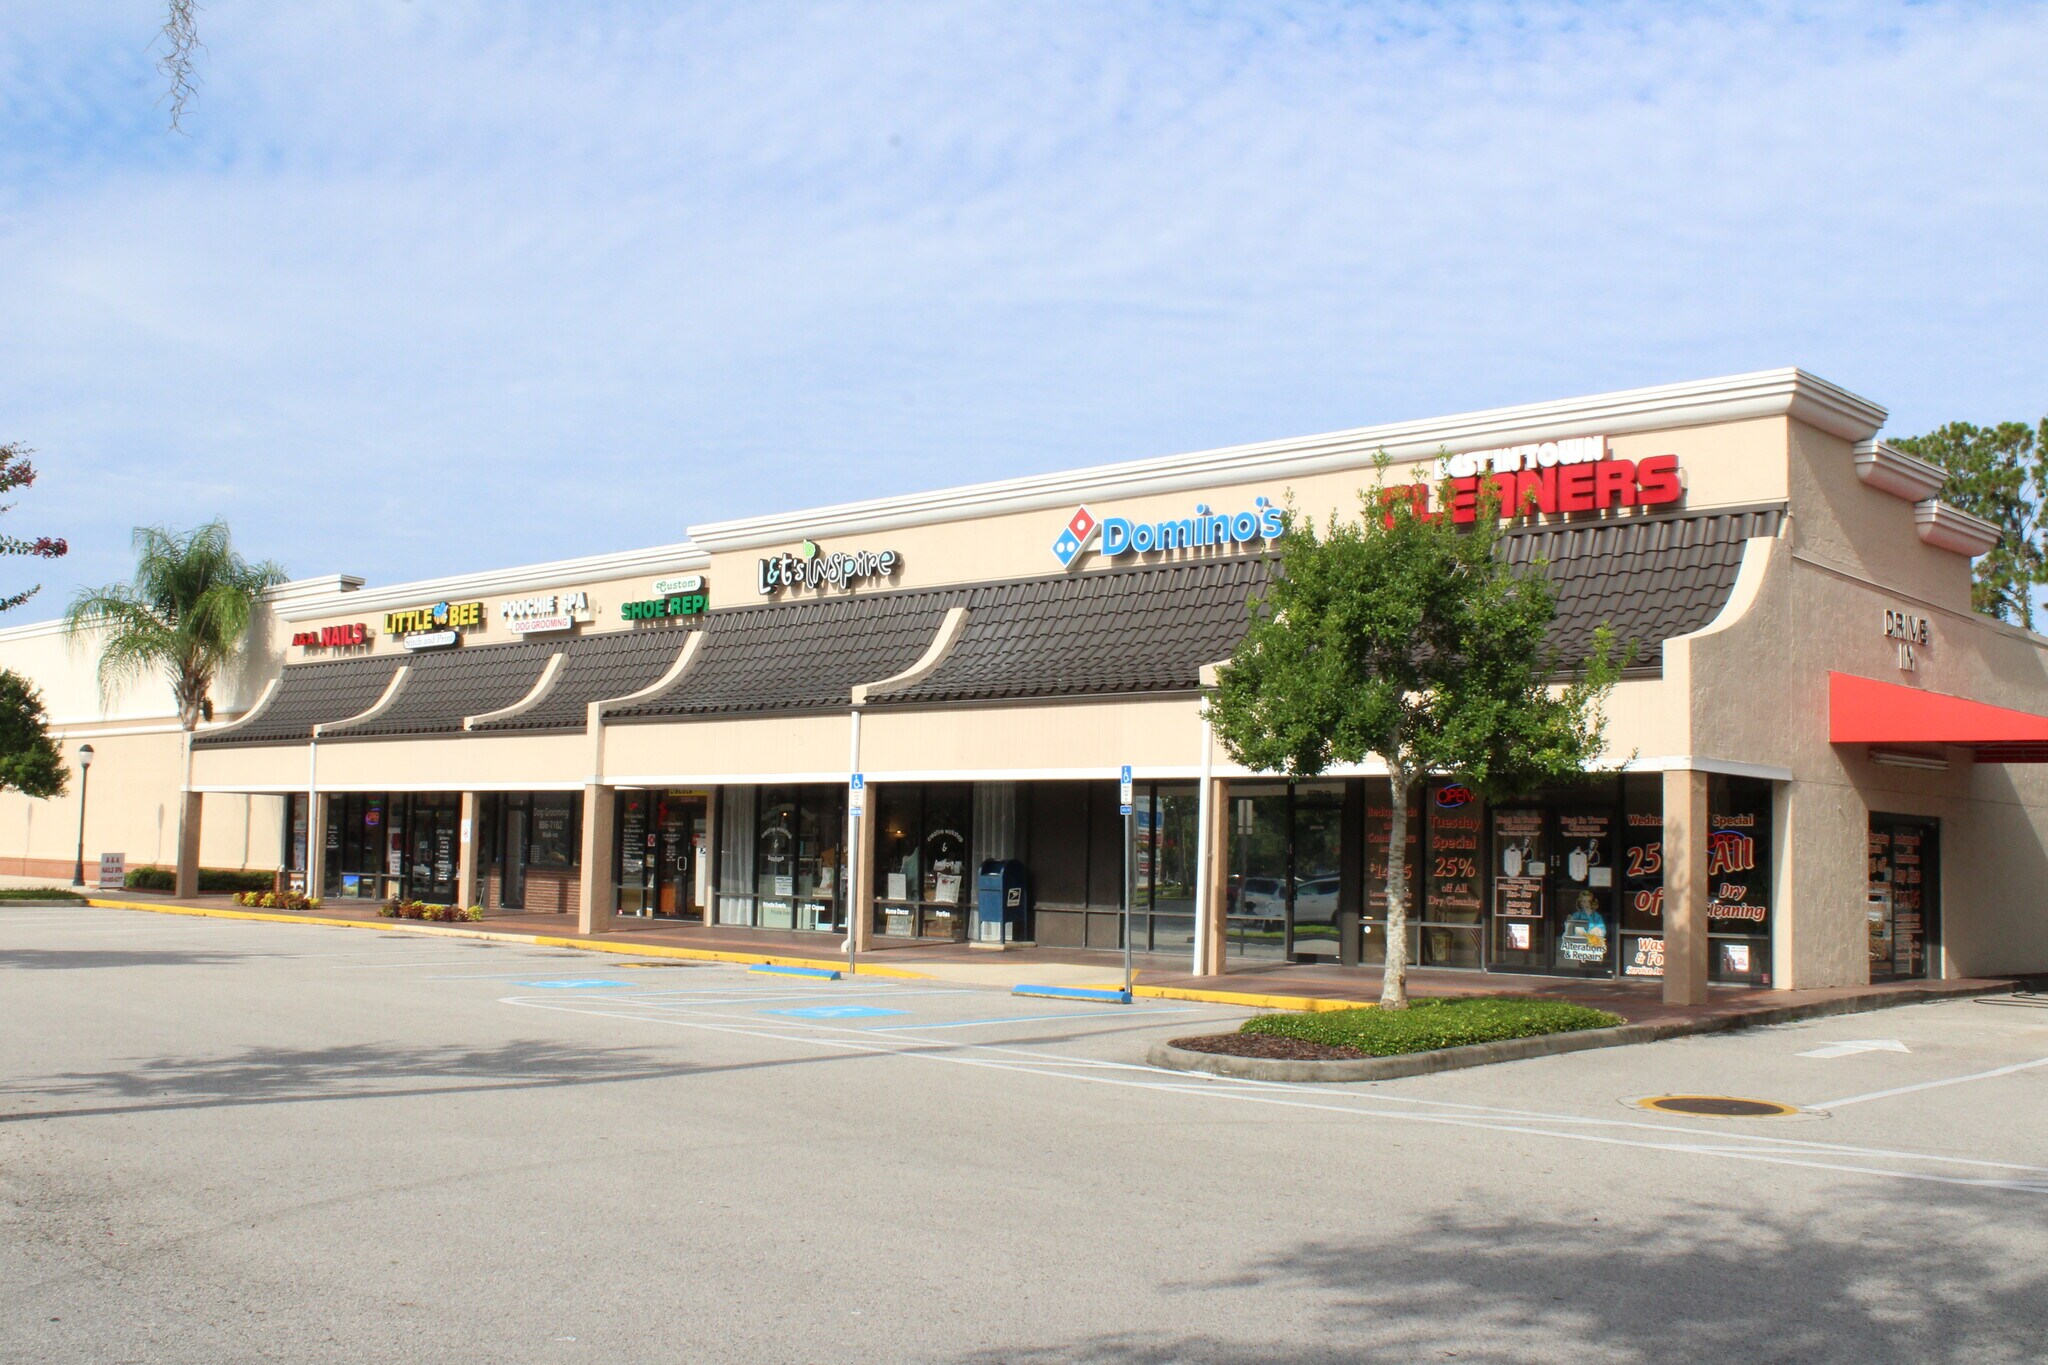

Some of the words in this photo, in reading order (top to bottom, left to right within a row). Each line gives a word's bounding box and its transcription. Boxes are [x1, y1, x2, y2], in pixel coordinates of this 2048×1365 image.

[1519, 436, 1604, 470] TOWN
[1101, 496, 1284, 556] Domino's
[656, 579, 696, 592] Custom
[501, 595, 556, 618] POOCHIE
[560, 592, 588, 611] SPA
[621, 600, 667, 620] SHOE
[670, 593, 710, 616] REPA
[384, 609, 433, 634] LITTLE
[449, 602, 481, 627] BEE
[515, 620, 530, 631] DOG
[531, 619, 568, 630] GROOMING
[320, 623, 366, 647] NAILS
[1884, 609, 1928, 645] DRIVE
[423, 634, 436, 646] and
[437, 632, 454, 645] Print
[1899, 643, 1915, 671] IN
[1436, 788, 1475, 803] OPEN
[1430, 815, 1480, 832] Tuesday
[1628, 814, 1663, 826] Wedne
[1713, 813, 1754, 829] Special
[1433, 835, 1477, 851] Special
[1627, 842, 1662, 876] 25
[1709, 837, 1755, 876] All
[1433, 857, 1476, 878] 25%
[1441, 883, 1453, 893] off
[1454, 883, 1468, 893] All
[1719, 883, 1747, 901] Dry
[1428, 895, 1443, 908] Dry
[1561, 941, 1607, 953] Alterations
[1638, 937, 1664, 953] Was
[1565, 951, 1571, 959] &
[1572, 951, 1603, 963] Repairs
[1635, 952, 1646, 965] &
[1647, 952, 1664, 966] Fo
